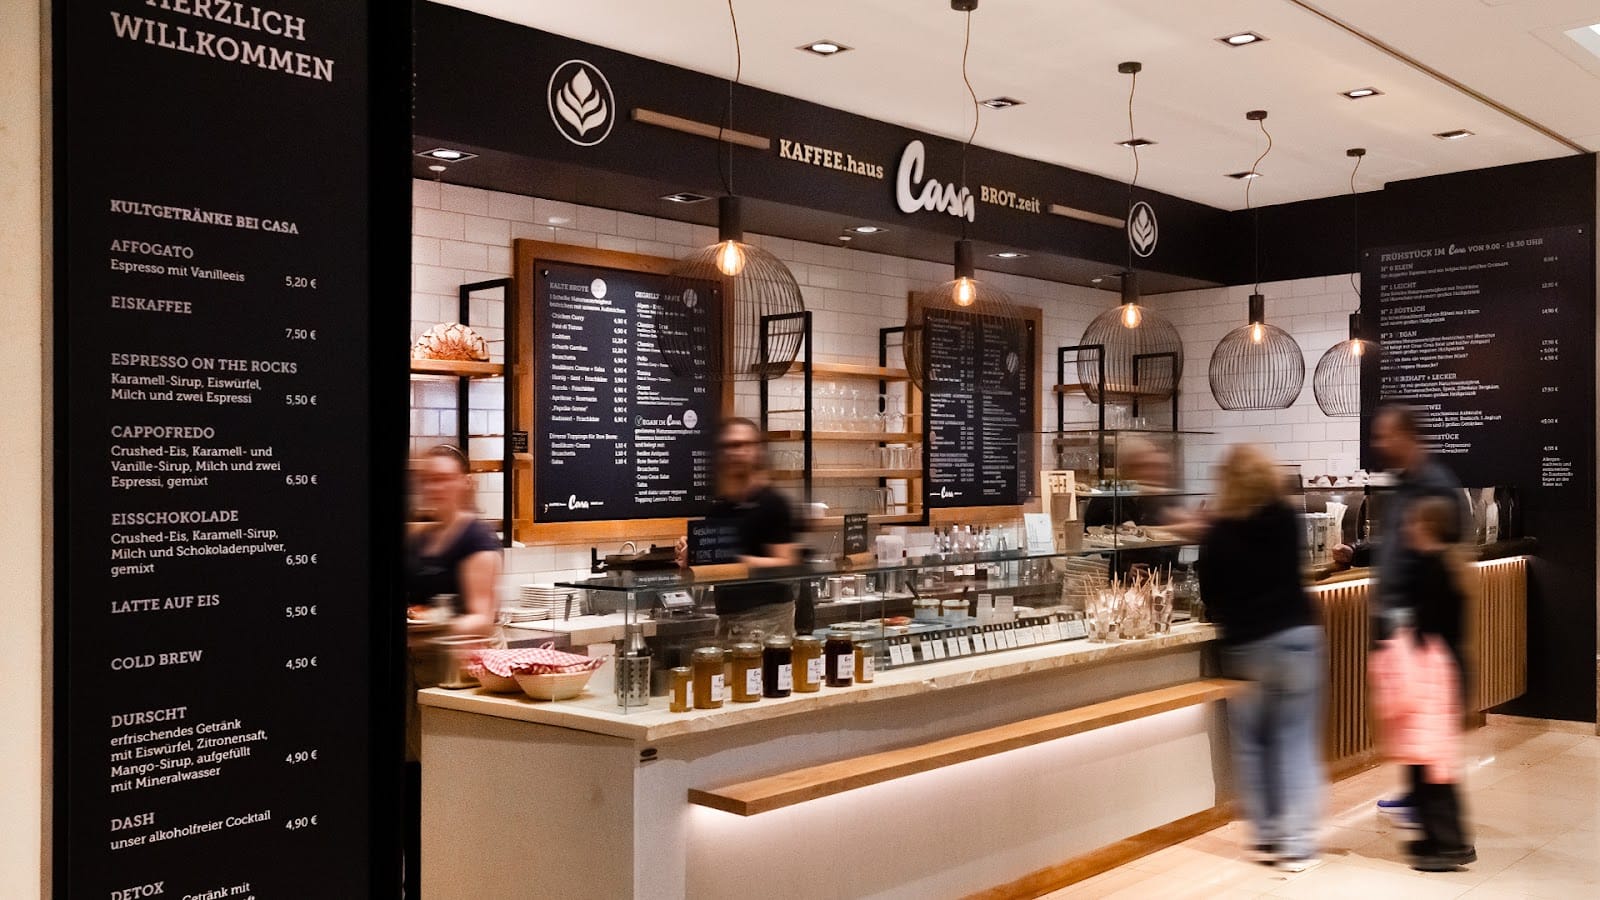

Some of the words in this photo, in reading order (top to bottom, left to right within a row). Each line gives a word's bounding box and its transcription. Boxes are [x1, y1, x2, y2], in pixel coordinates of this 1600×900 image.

[110, 11, 335, 82] WILLKOMMEN
[779, 138, 884, 180] KAFFEE.haus
[896, 140, 975, 223] Casa
[980, 185, 1041, 214] BROT.zeit
[110, 199, 233, 227] KULTGETRÄNKE
[235, 216, 259, 230] BEI
[261, 219, 299, 235] CASA
[110, 239, 194, 260] AFFOGATO
[1434, 247, 1445, 256] IM
[1468, 244, 1485, 253] VON
[110, 258, 165, 274] Espresso
[167, 265, 188, 277] mit
[190, 266, 246, 282] Vanilleeis
[285, 276, 308, 289] 5,20
[310, 278, 317, 289] €
[111, 296, 193, 314] EISKAFFEE
[285, 328, 308, 340] 7,50
[310, 330, 317, 340] €
[1399, 330, 1418, 338] EGAN
[111, 353, 188, 369] ESPRESSO
[191, 357, 215, 370] ON
[218, 358, 248, 371] THE
[251, 360, 298, 374] ROCKS
[111, 373, 204, 389] Karamell-Sirup,
[207, 377, 262, 391] Eiswürfel,
[111, 389, 146, 400] Milch
[149, 390, 173, 401] und
[176, 391, 204, 402] zwei
[206, 392, 252, 405] Espressi
[285, 394, 308, 406] 5,50
[310, 395, 317, 405] €
[111, 425, 215, 439] CAPPOFREDO
[111, 445, 189, 458] Crushed-Eis,
[192, 446, 247, 457] Karamell-
[250, 446, 273, 457] und
[111, 460, 193, 474] Vanille-Sirup,
[195, 460, 229, 471] Milch
[231, 461, 253, 471] und
[255, 461, 281, 471] zwei
[111, 476, 164, 489] Espressi,
[167, 476, 209, 489] gemixt
[286, 474, 308, 486] 6,50
[310, 475, 318, 485] €
[111, 510, 239, 526] EISSCHOKOLADE
[111, 531, 189, 545] Crushed-Eis,
[192, 528, 279, 542] Karamell-Sirup,
[111, 548, 146, 560] Milch
[149, 546, 173, 558] und
[176, 542, 286, 557] Schokoladenpulver,
[286, 554, 308, 566] 6,50
[310, 553, 318, 564] €
[111, 564, 155, 577] gemixt
[111, 597, 160, 614] LATTE
[163, 595, 194, 610] AUF
[197, 594, 220, 607] EIS
[286, 606, 308, 618] 5,50
[310, 605, 317, 615] €
[111, 655, 155, 671] COLD
[159, 650, 203, 666] BREW
[285, 658, 308, 670] 4,50
[310, 656, 317, 667] €
[111, 706, 187, 728] DURSCHT
[110, 725, 194, 747] erfrischendes
[196, 719, 242, 735] Getränk
[110, 749, 132, 762] mit
[135, 740, 194, 759] Eiswürfel,
[196, 729, 268, 749] Zitronensaft,
[110, 756, 194, 777] Mango-Sirup,
[196, 747, 251, 764] aufgefüllt
[285, 751, 309, 764] 4,90
[310, 750, 318, 761] €
[110, 780, 132, 793] mit
[135, 767, 221, 790] Mineralwasser
[110, 835, 146, 850] unser
[149, 820, 224, 843] alkoholfreier
[225, 810, 271, 828] Cocktail
[111, 812, 155, 832] DASH
[285, 817, 309, 831] 4,90
[310, 815, 318, 826] €
[111, 881, 165, 900] DETOX
[231, 882, 251, 895] mit
